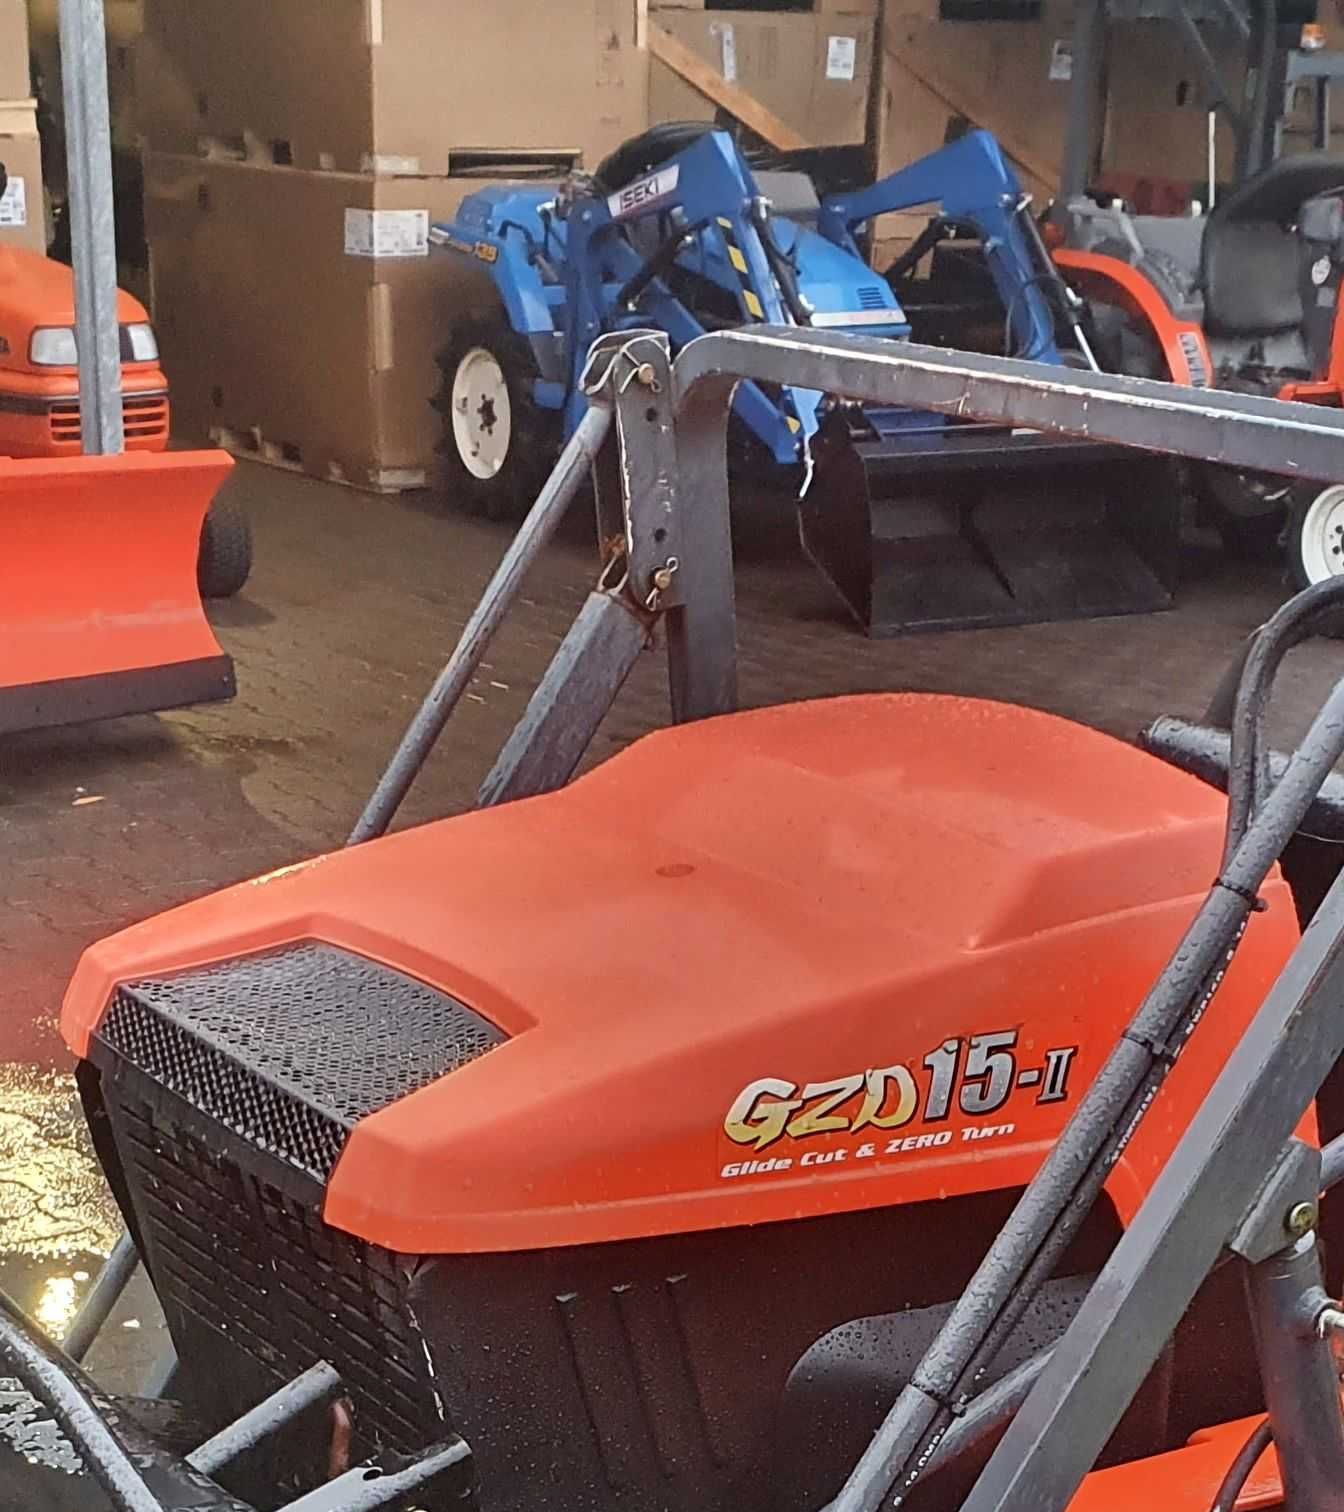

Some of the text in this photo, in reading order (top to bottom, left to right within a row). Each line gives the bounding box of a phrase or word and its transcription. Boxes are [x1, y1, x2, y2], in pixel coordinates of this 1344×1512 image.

[619, 176, 660, 211] ISEKI
[720, 1123, 1016, 1178] Glide Cut & ZERO Turn
